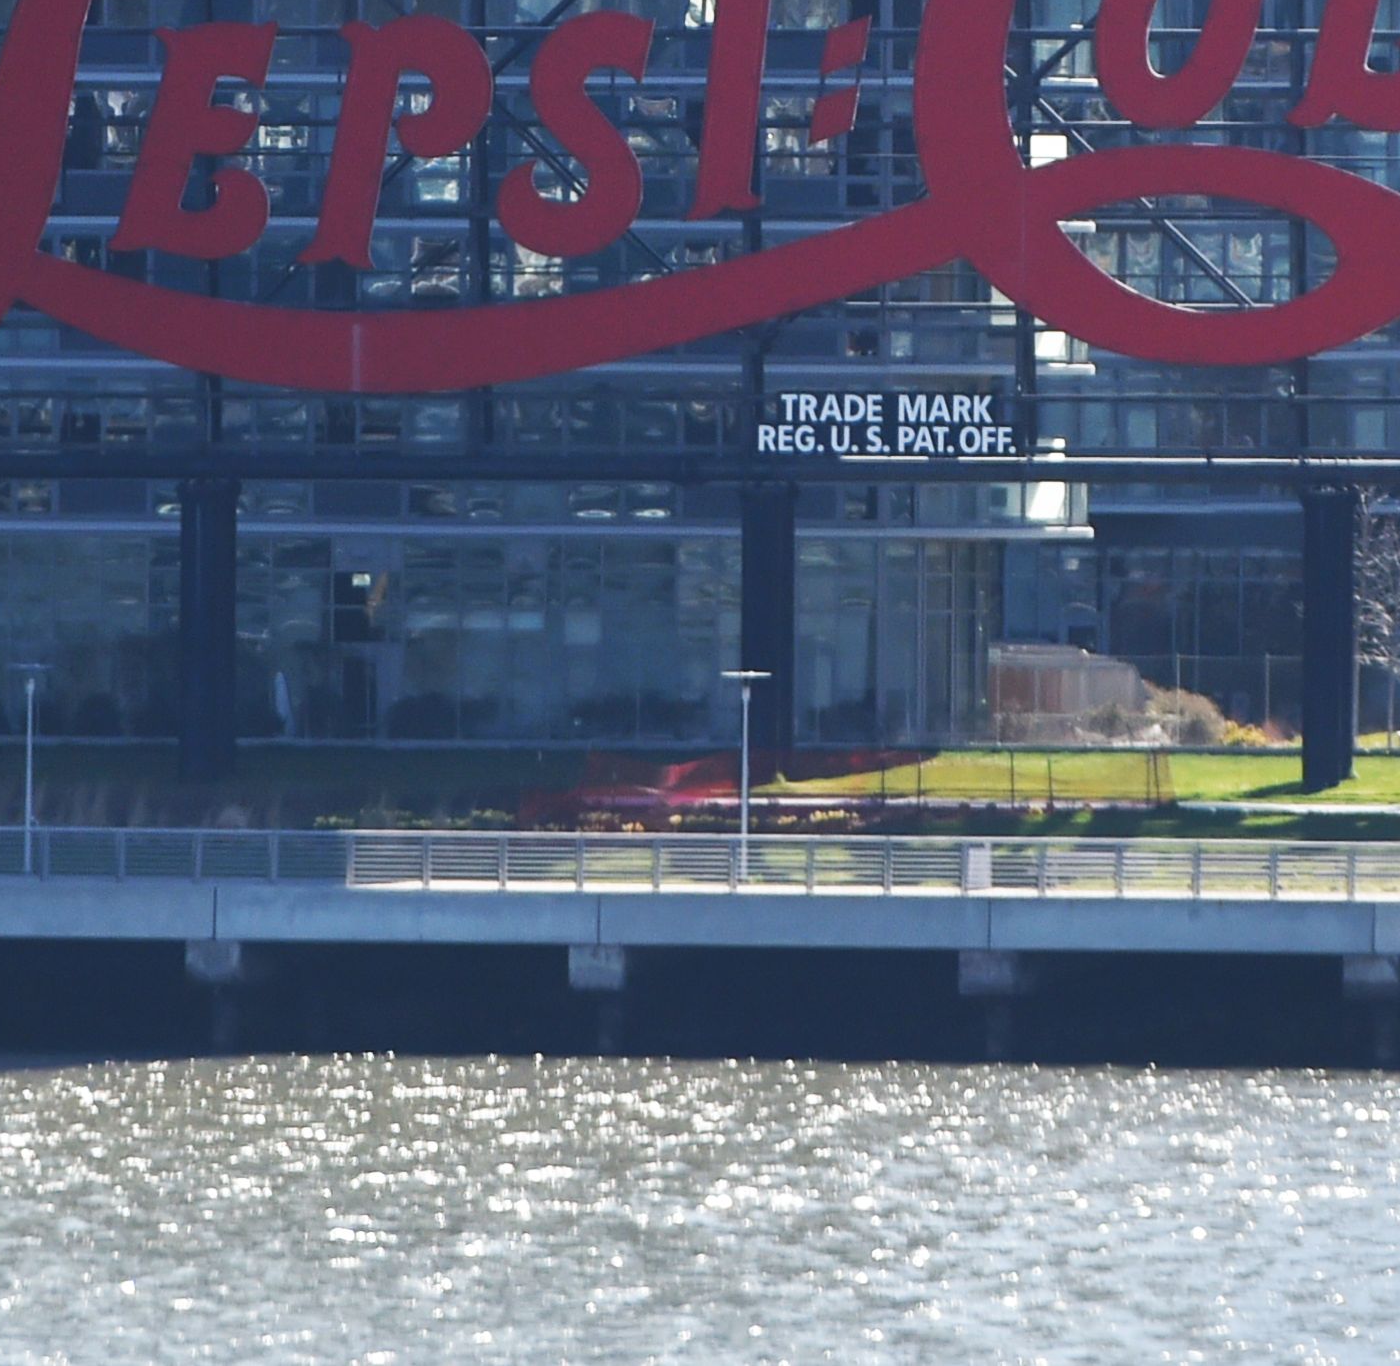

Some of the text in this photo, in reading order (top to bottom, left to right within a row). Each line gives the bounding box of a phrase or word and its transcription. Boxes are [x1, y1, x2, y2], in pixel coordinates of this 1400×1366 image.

[781, 393, 993, 423] TRADE MARK
[758, 424, 824, 452] REG.
[898, 426, 955, 453] PAT.
[959, 427, 1016, 454] OFF.
